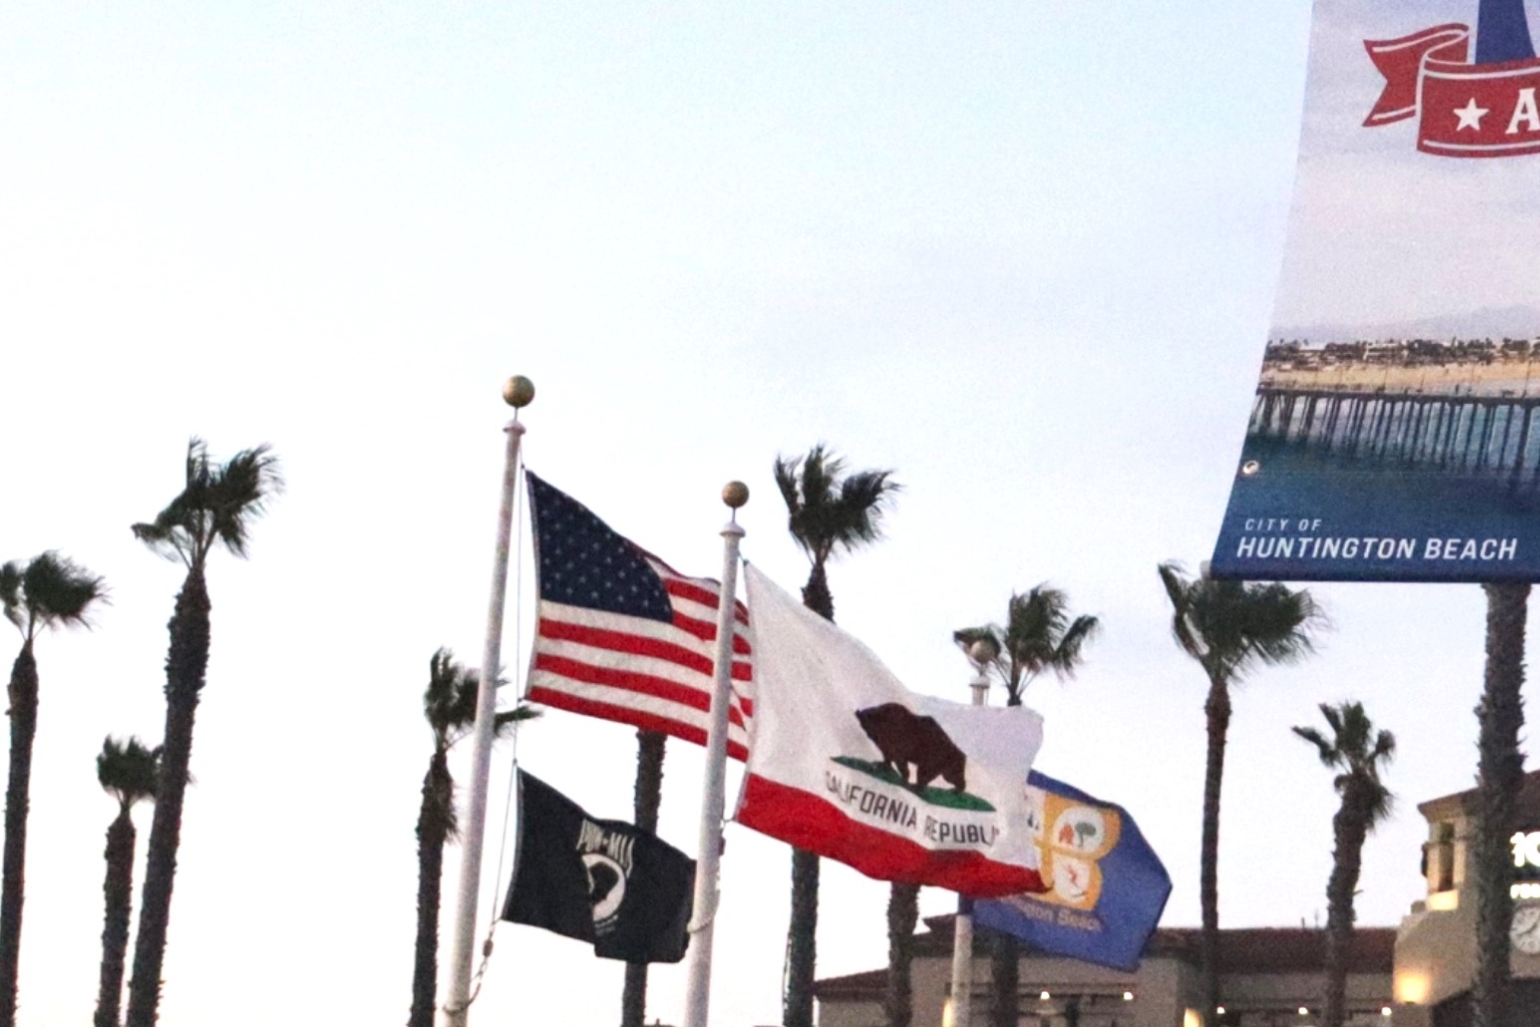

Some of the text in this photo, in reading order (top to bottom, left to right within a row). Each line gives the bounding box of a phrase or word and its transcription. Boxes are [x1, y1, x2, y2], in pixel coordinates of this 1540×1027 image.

[1244, 518, 1322, 531] CITY OF
[1236, 537, 1518, 560] HUNTINGTON BEACH
[923, 814, 1000, 847] REPUBLI
